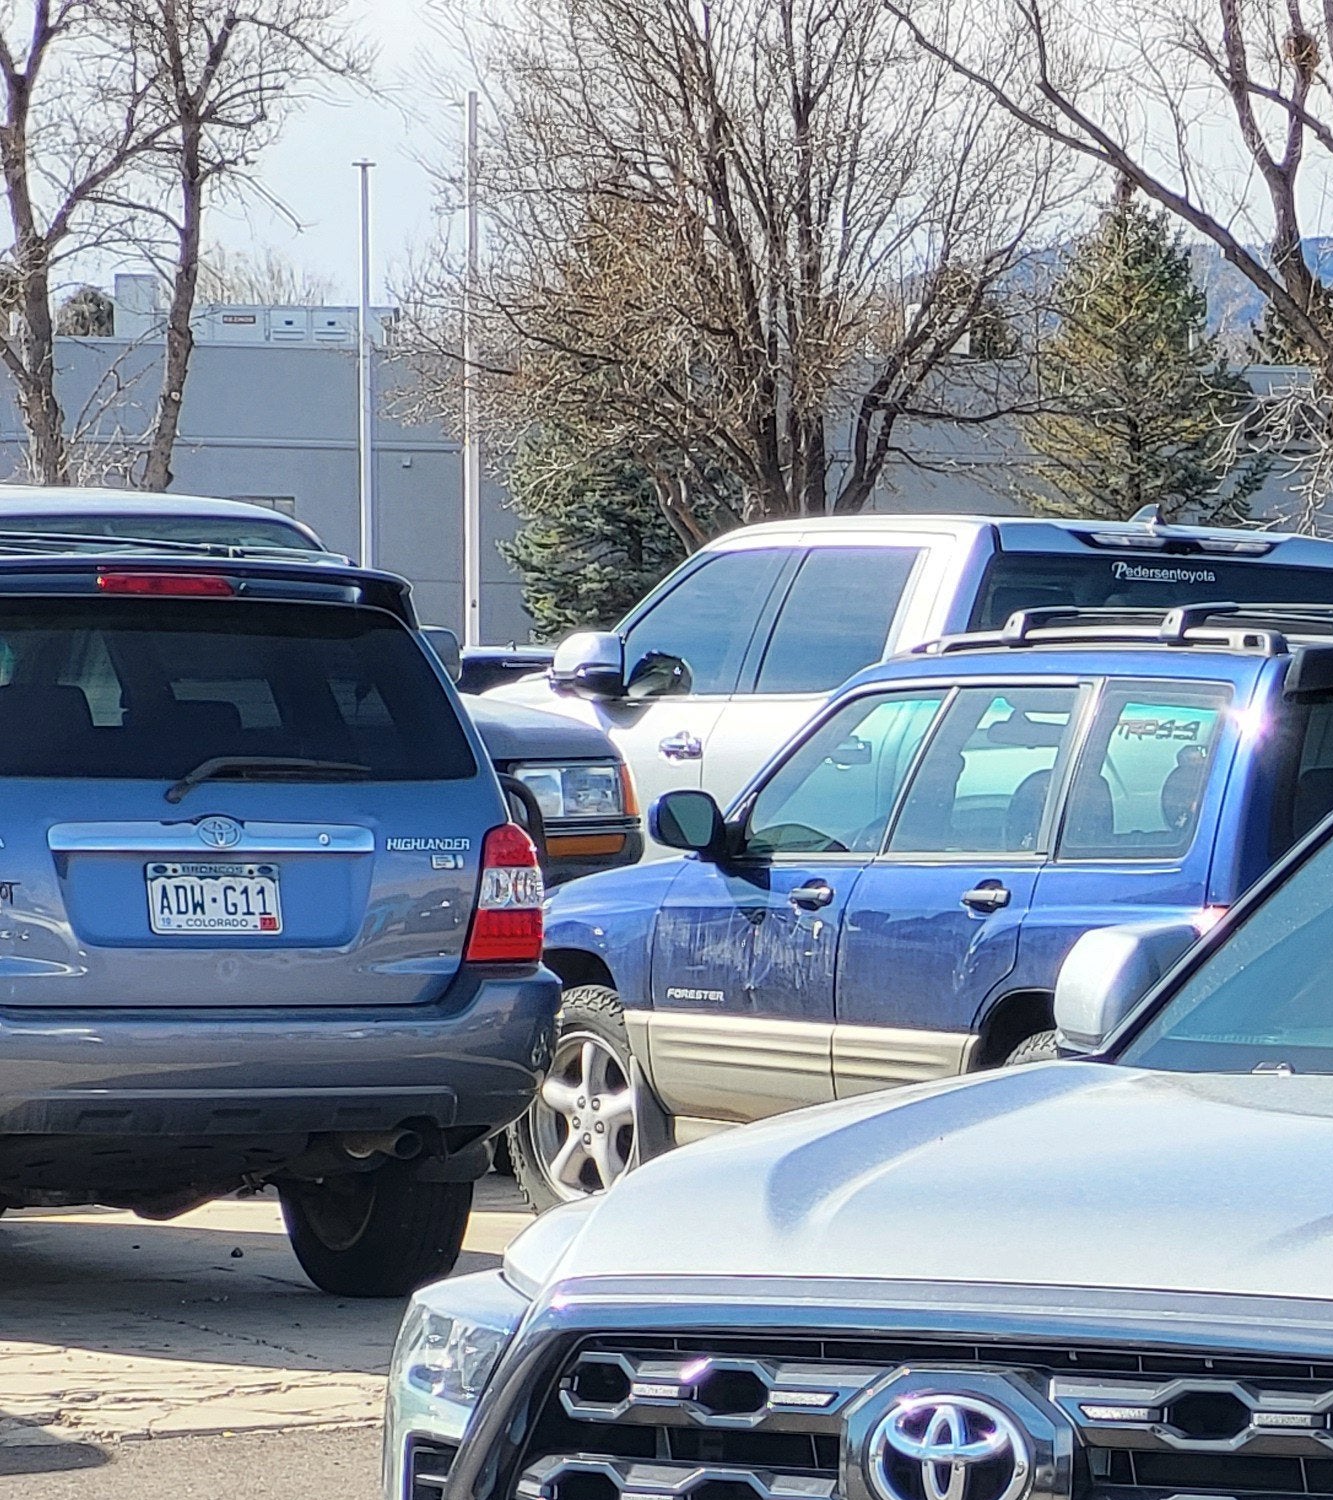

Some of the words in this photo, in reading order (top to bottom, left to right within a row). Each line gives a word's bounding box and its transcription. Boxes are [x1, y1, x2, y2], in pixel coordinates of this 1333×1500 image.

[386, 837, 470, 851] HIGHLANDER
[186, 918, 249, 928] COLORADO
[667, 987, 724, 1002] FORESTER
